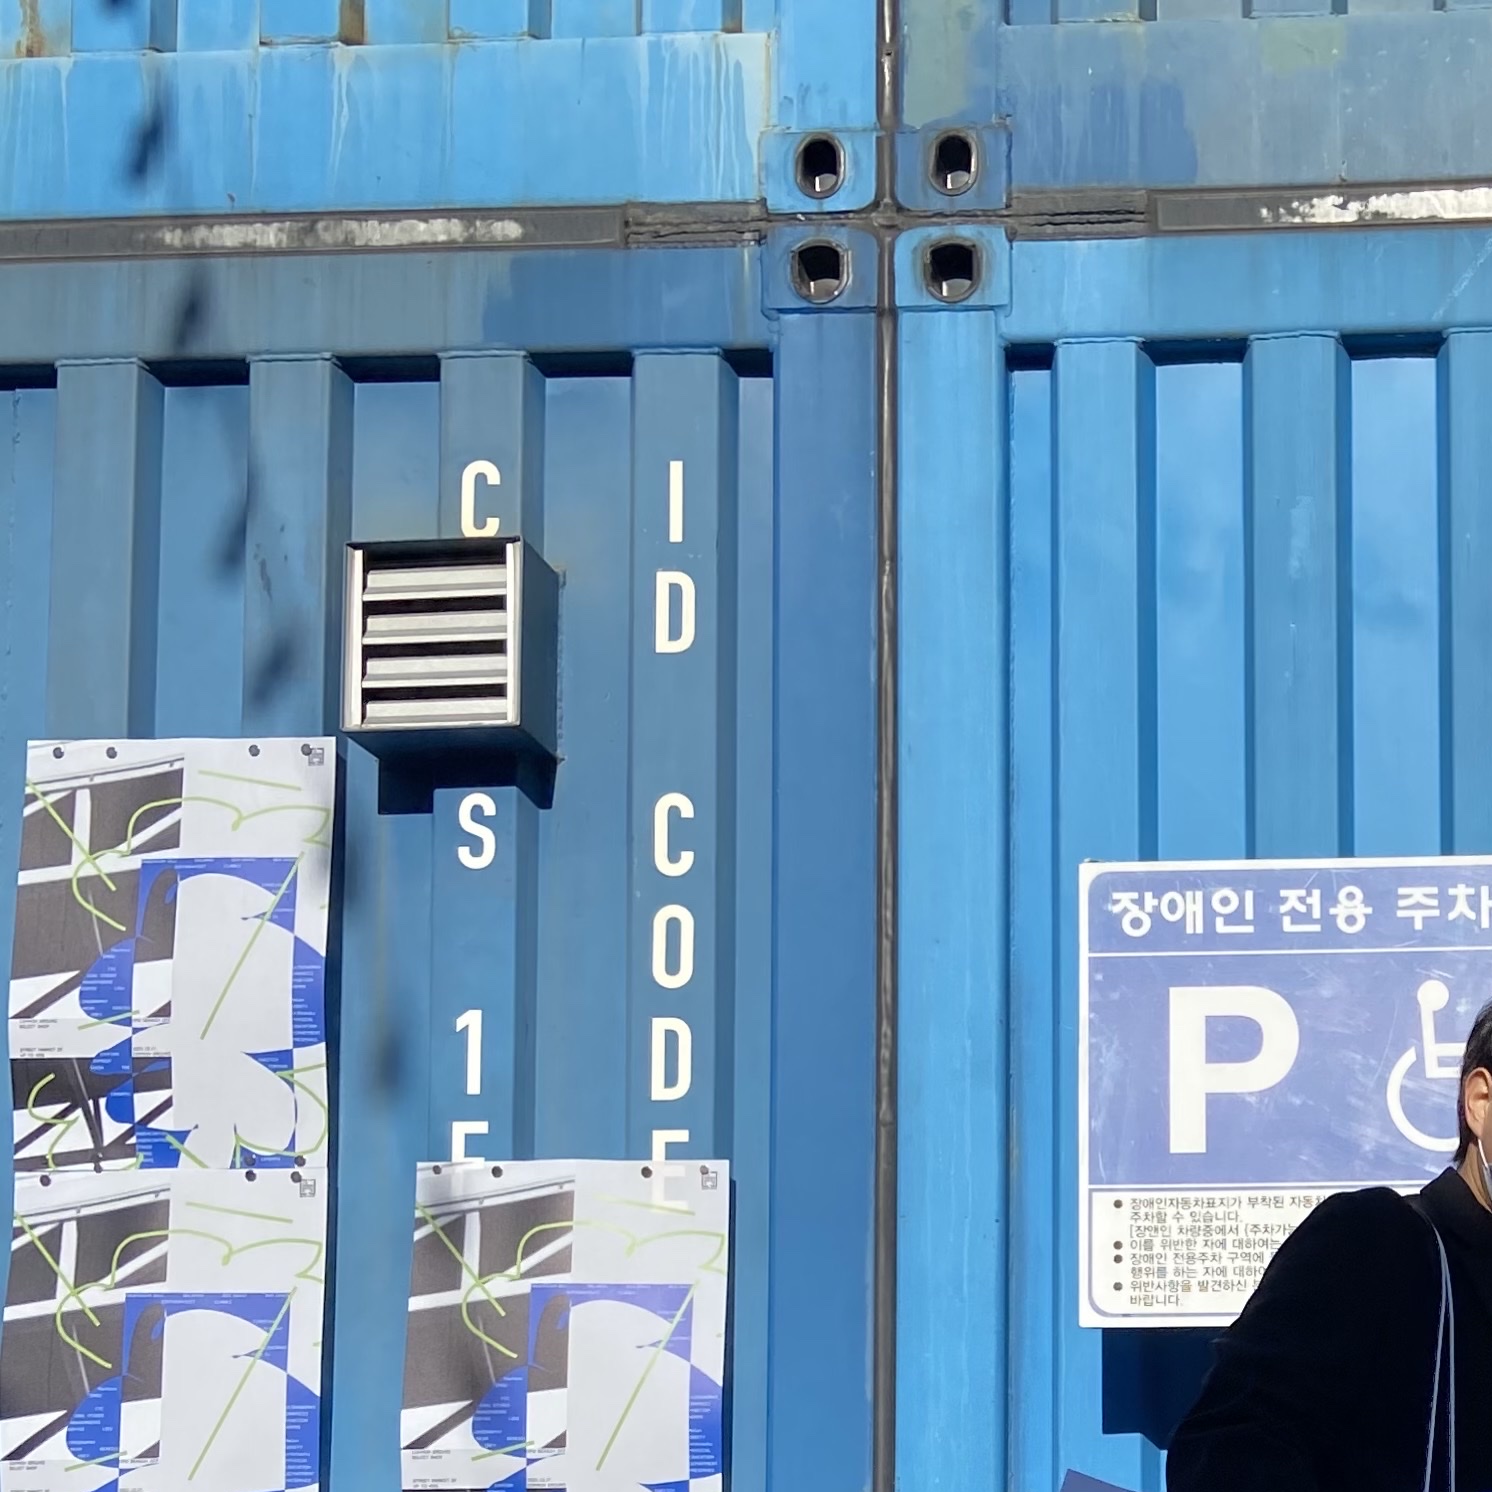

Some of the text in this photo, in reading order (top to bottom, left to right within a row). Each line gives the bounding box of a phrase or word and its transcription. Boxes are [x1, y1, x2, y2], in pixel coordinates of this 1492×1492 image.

[654, 460, 696, 653] ID
[1111, 888, 1255, 938] 장애인
[1278, 884, 1373, 935] 전용
[1168, 985, 1300, 1154] P
[1129, 1196, 1241, 1211] 장애인자동차표지가
[1247, 1195, 1285, 1209] 부착된
[1130, 1210, 1168, 1224] 주차할
[1171, 1210, 1186, 1223] 수
[1129, 1238, 1154, 1252] 이를
[1159, 1238, 1198, 1251] 위반한
[1202, 1238, 1227, 1251] 자에
[1129, 1252, 1168, 1266] 장애인
[1226, 1250, 1265, 1264] 구역에
[1172, 1266, 1199, 1279] 하는
[1202, 1265, 1228, 1279] 자에
[1130, 1279, 1193, 1293] 위반사항을
